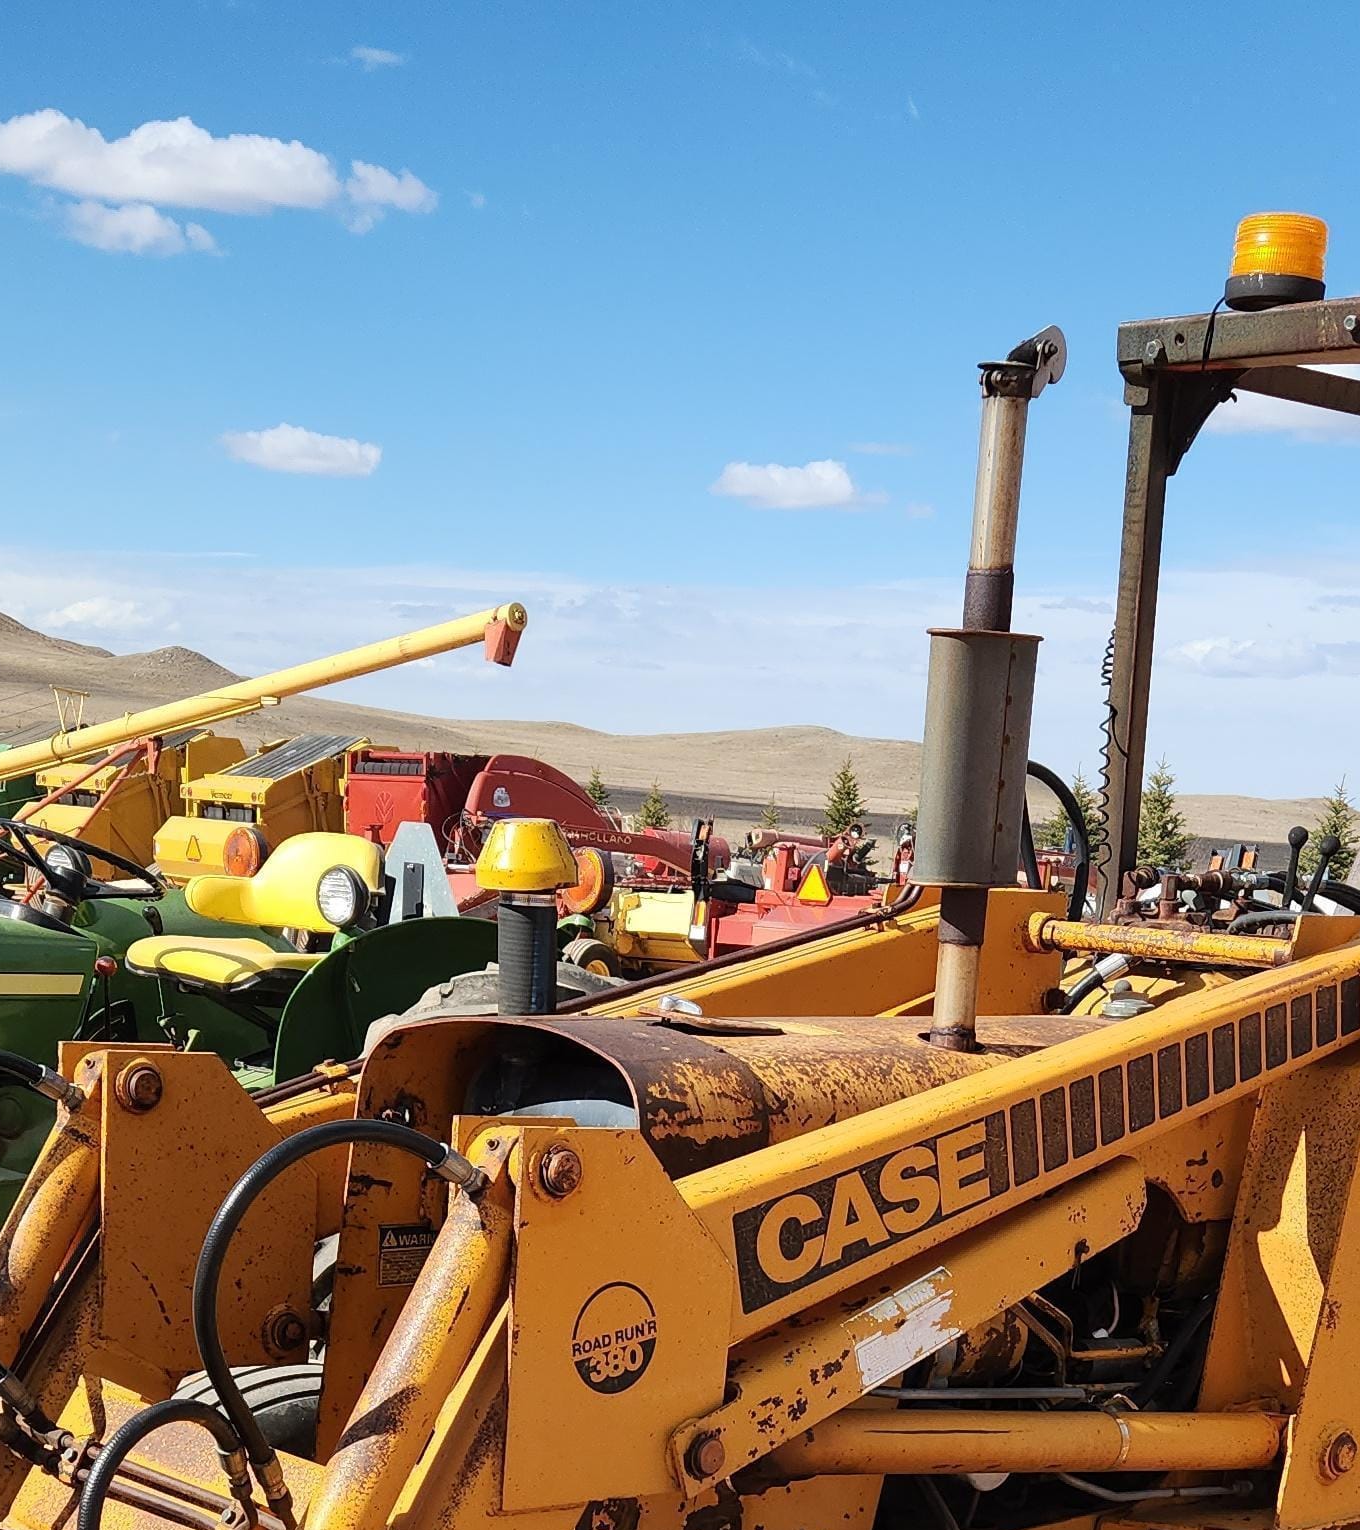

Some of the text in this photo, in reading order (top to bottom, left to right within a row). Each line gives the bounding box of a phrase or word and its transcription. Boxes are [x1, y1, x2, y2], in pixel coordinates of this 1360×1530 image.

[580, 832, 632, 845] HOLLAND
[756, 1118, 991, 1284] CASE
[398, 1233, 436, 1246] WARN
[572, 1319, 658, 1358] ROAD RUN'R
[588, 1342, 645, 1384] 380
